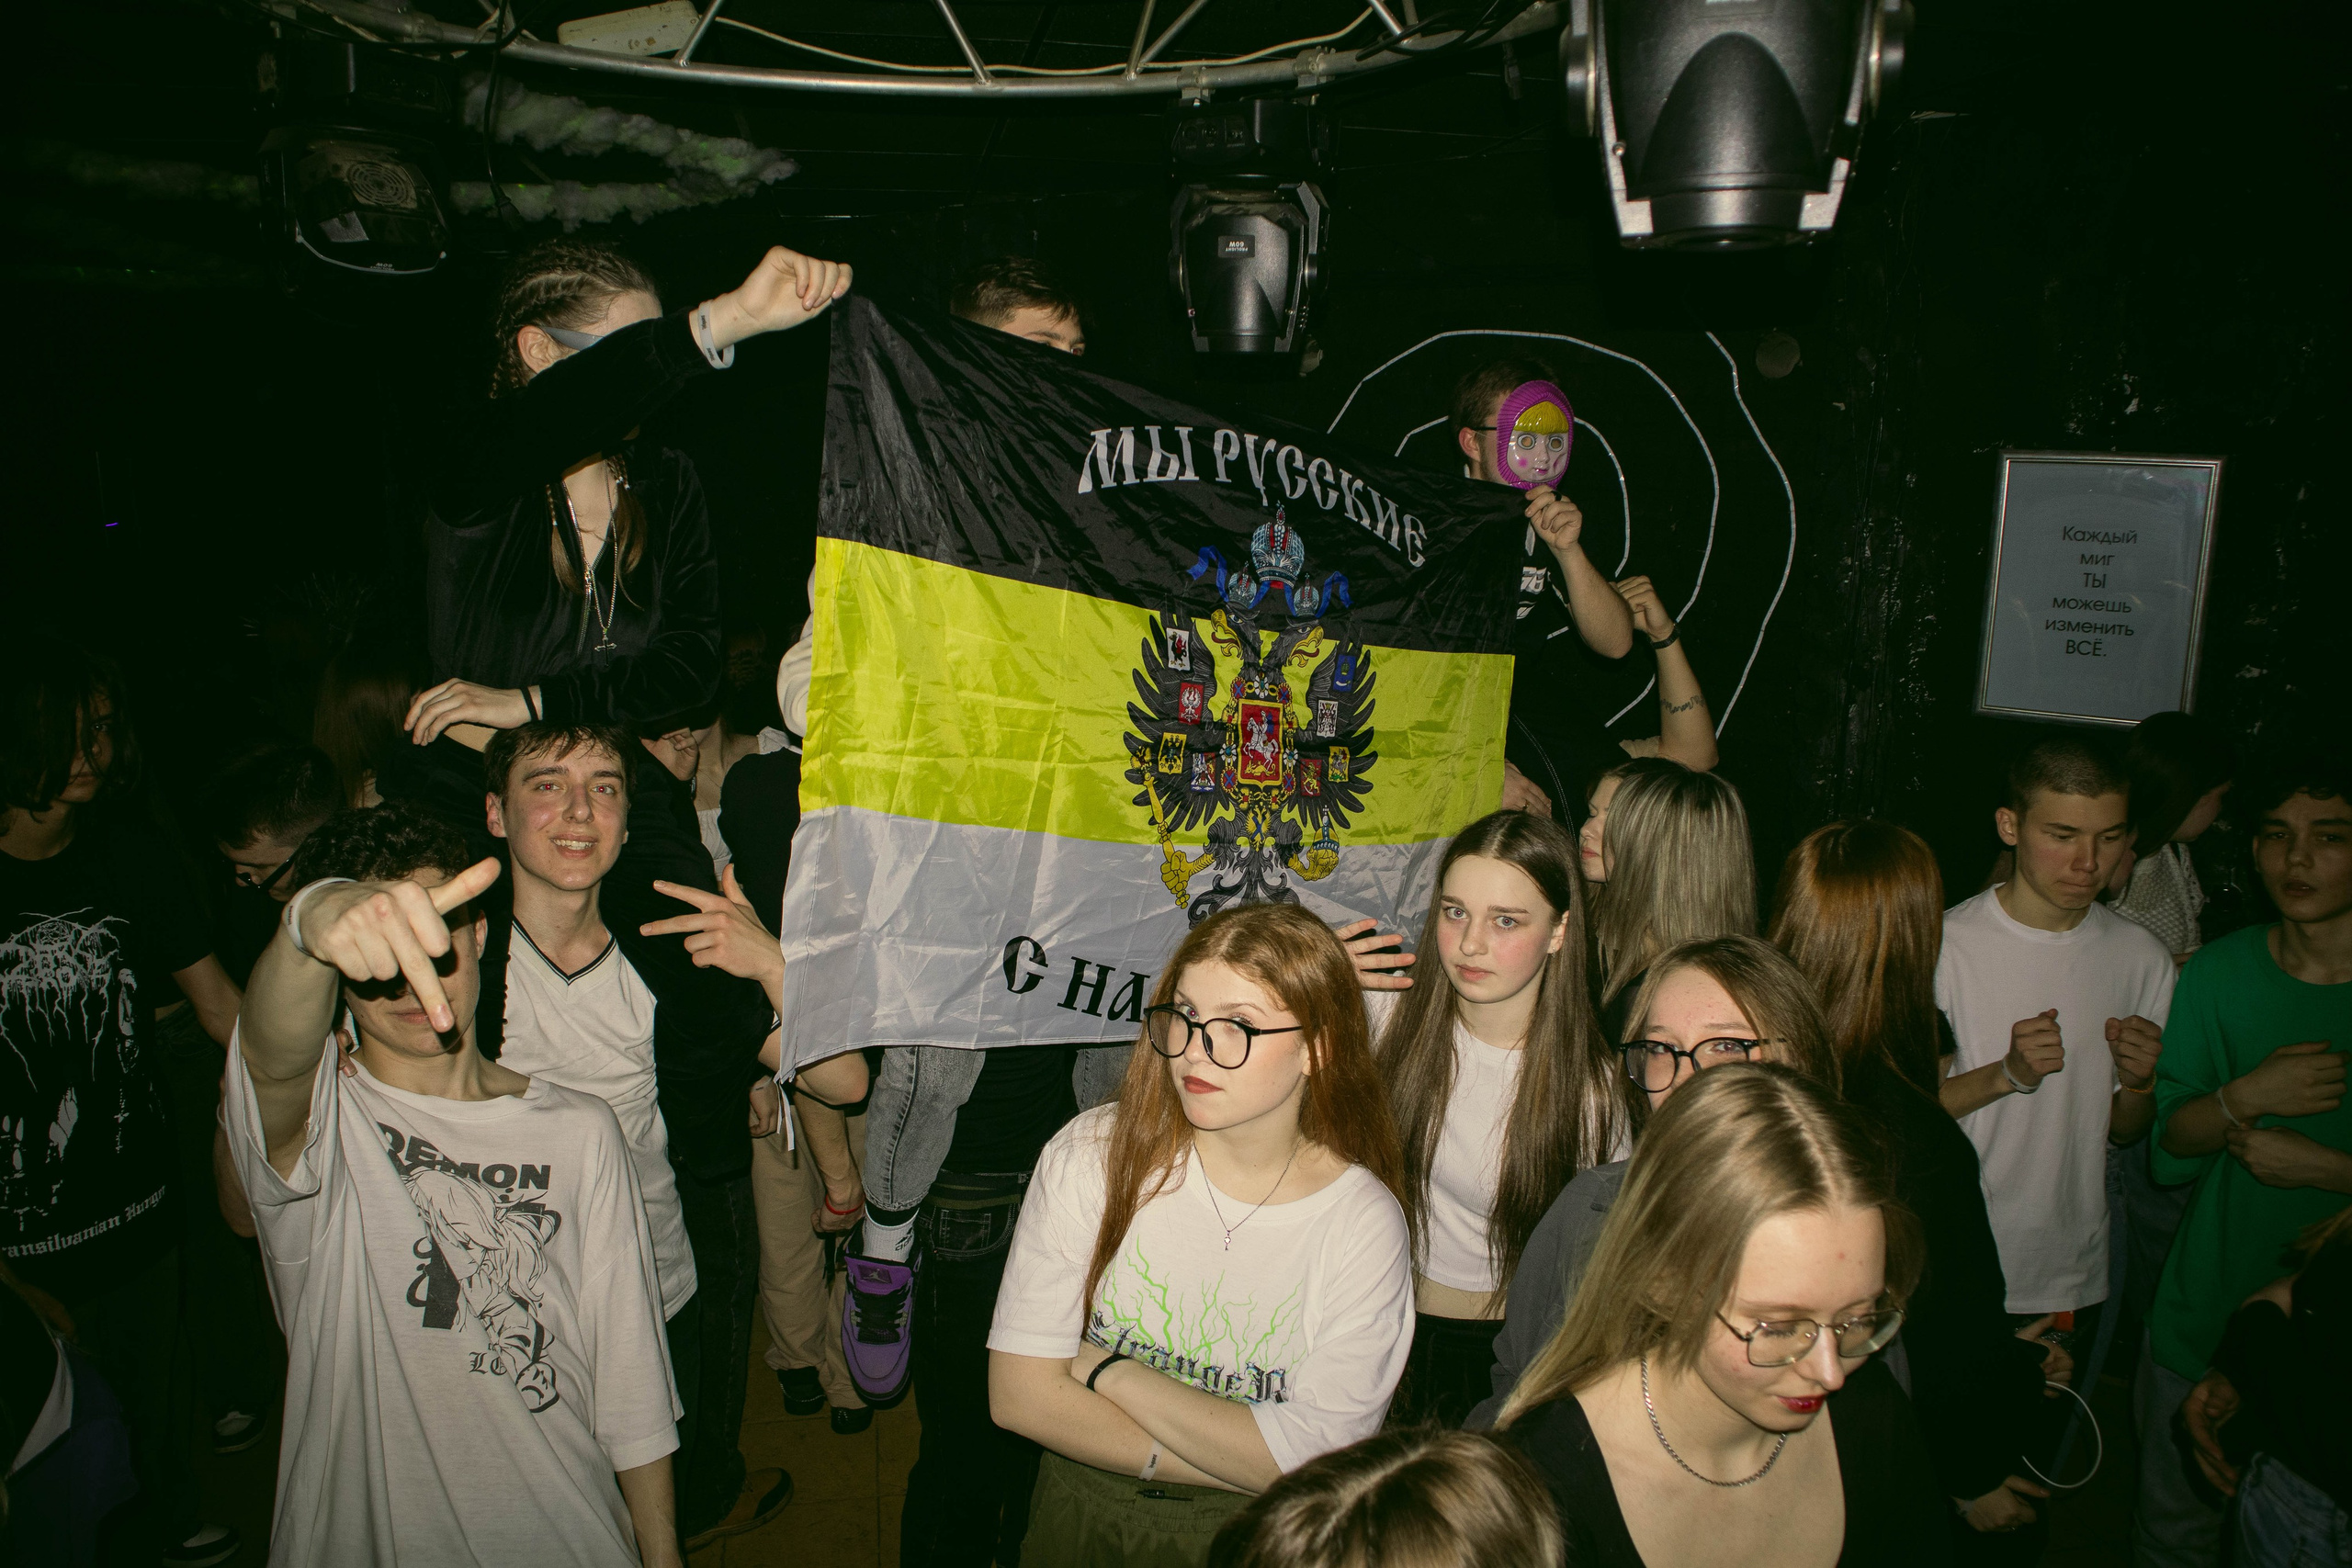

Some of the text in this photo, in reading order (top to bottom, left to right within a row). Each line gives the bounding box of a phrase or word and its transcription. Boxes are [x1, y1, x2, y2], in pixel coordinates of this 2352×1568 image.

[1078, 425, 1429, 568] МЫ РУССКИЕ
[2062, 525, 2138, 545] Каждый
[2079, 553, 2116, 566] миг
[2083, 572, 2107, 589] ТЫ
[2052, 597, 2132, 614] можешь
[2044, 619, 2135, 637] изменить
[2064, 638, 2108, 657] ВСЁ.
[1057, 955, 1151, 1023] НА
[2, 1214, 121, 1258] ansilvanian
